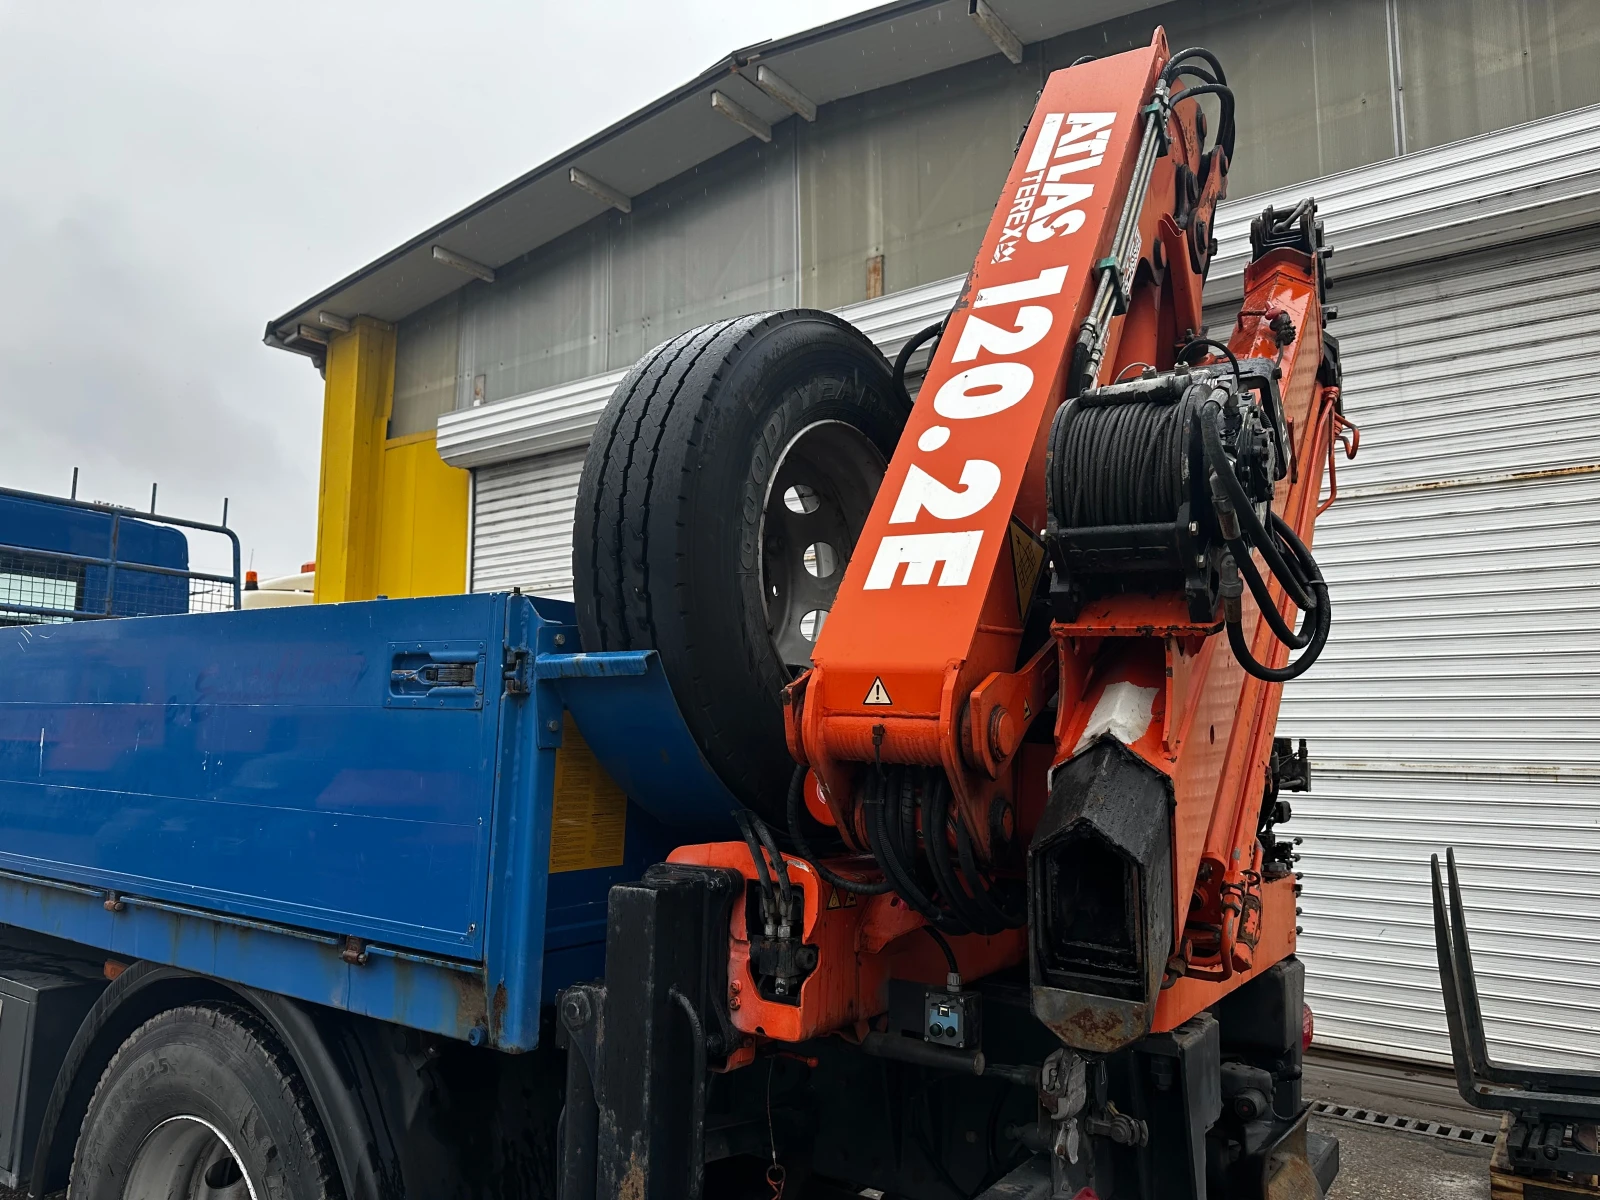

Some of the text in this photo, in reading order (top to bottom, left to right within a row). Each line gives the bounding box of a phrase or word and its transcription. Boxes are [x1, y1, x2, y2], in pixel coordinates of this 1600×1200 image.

[998, 170, 1046, 243] TEREX
[1027, 112, 1117, 242] ATLAS
[863, 265, 1069, 590] 120.2E
